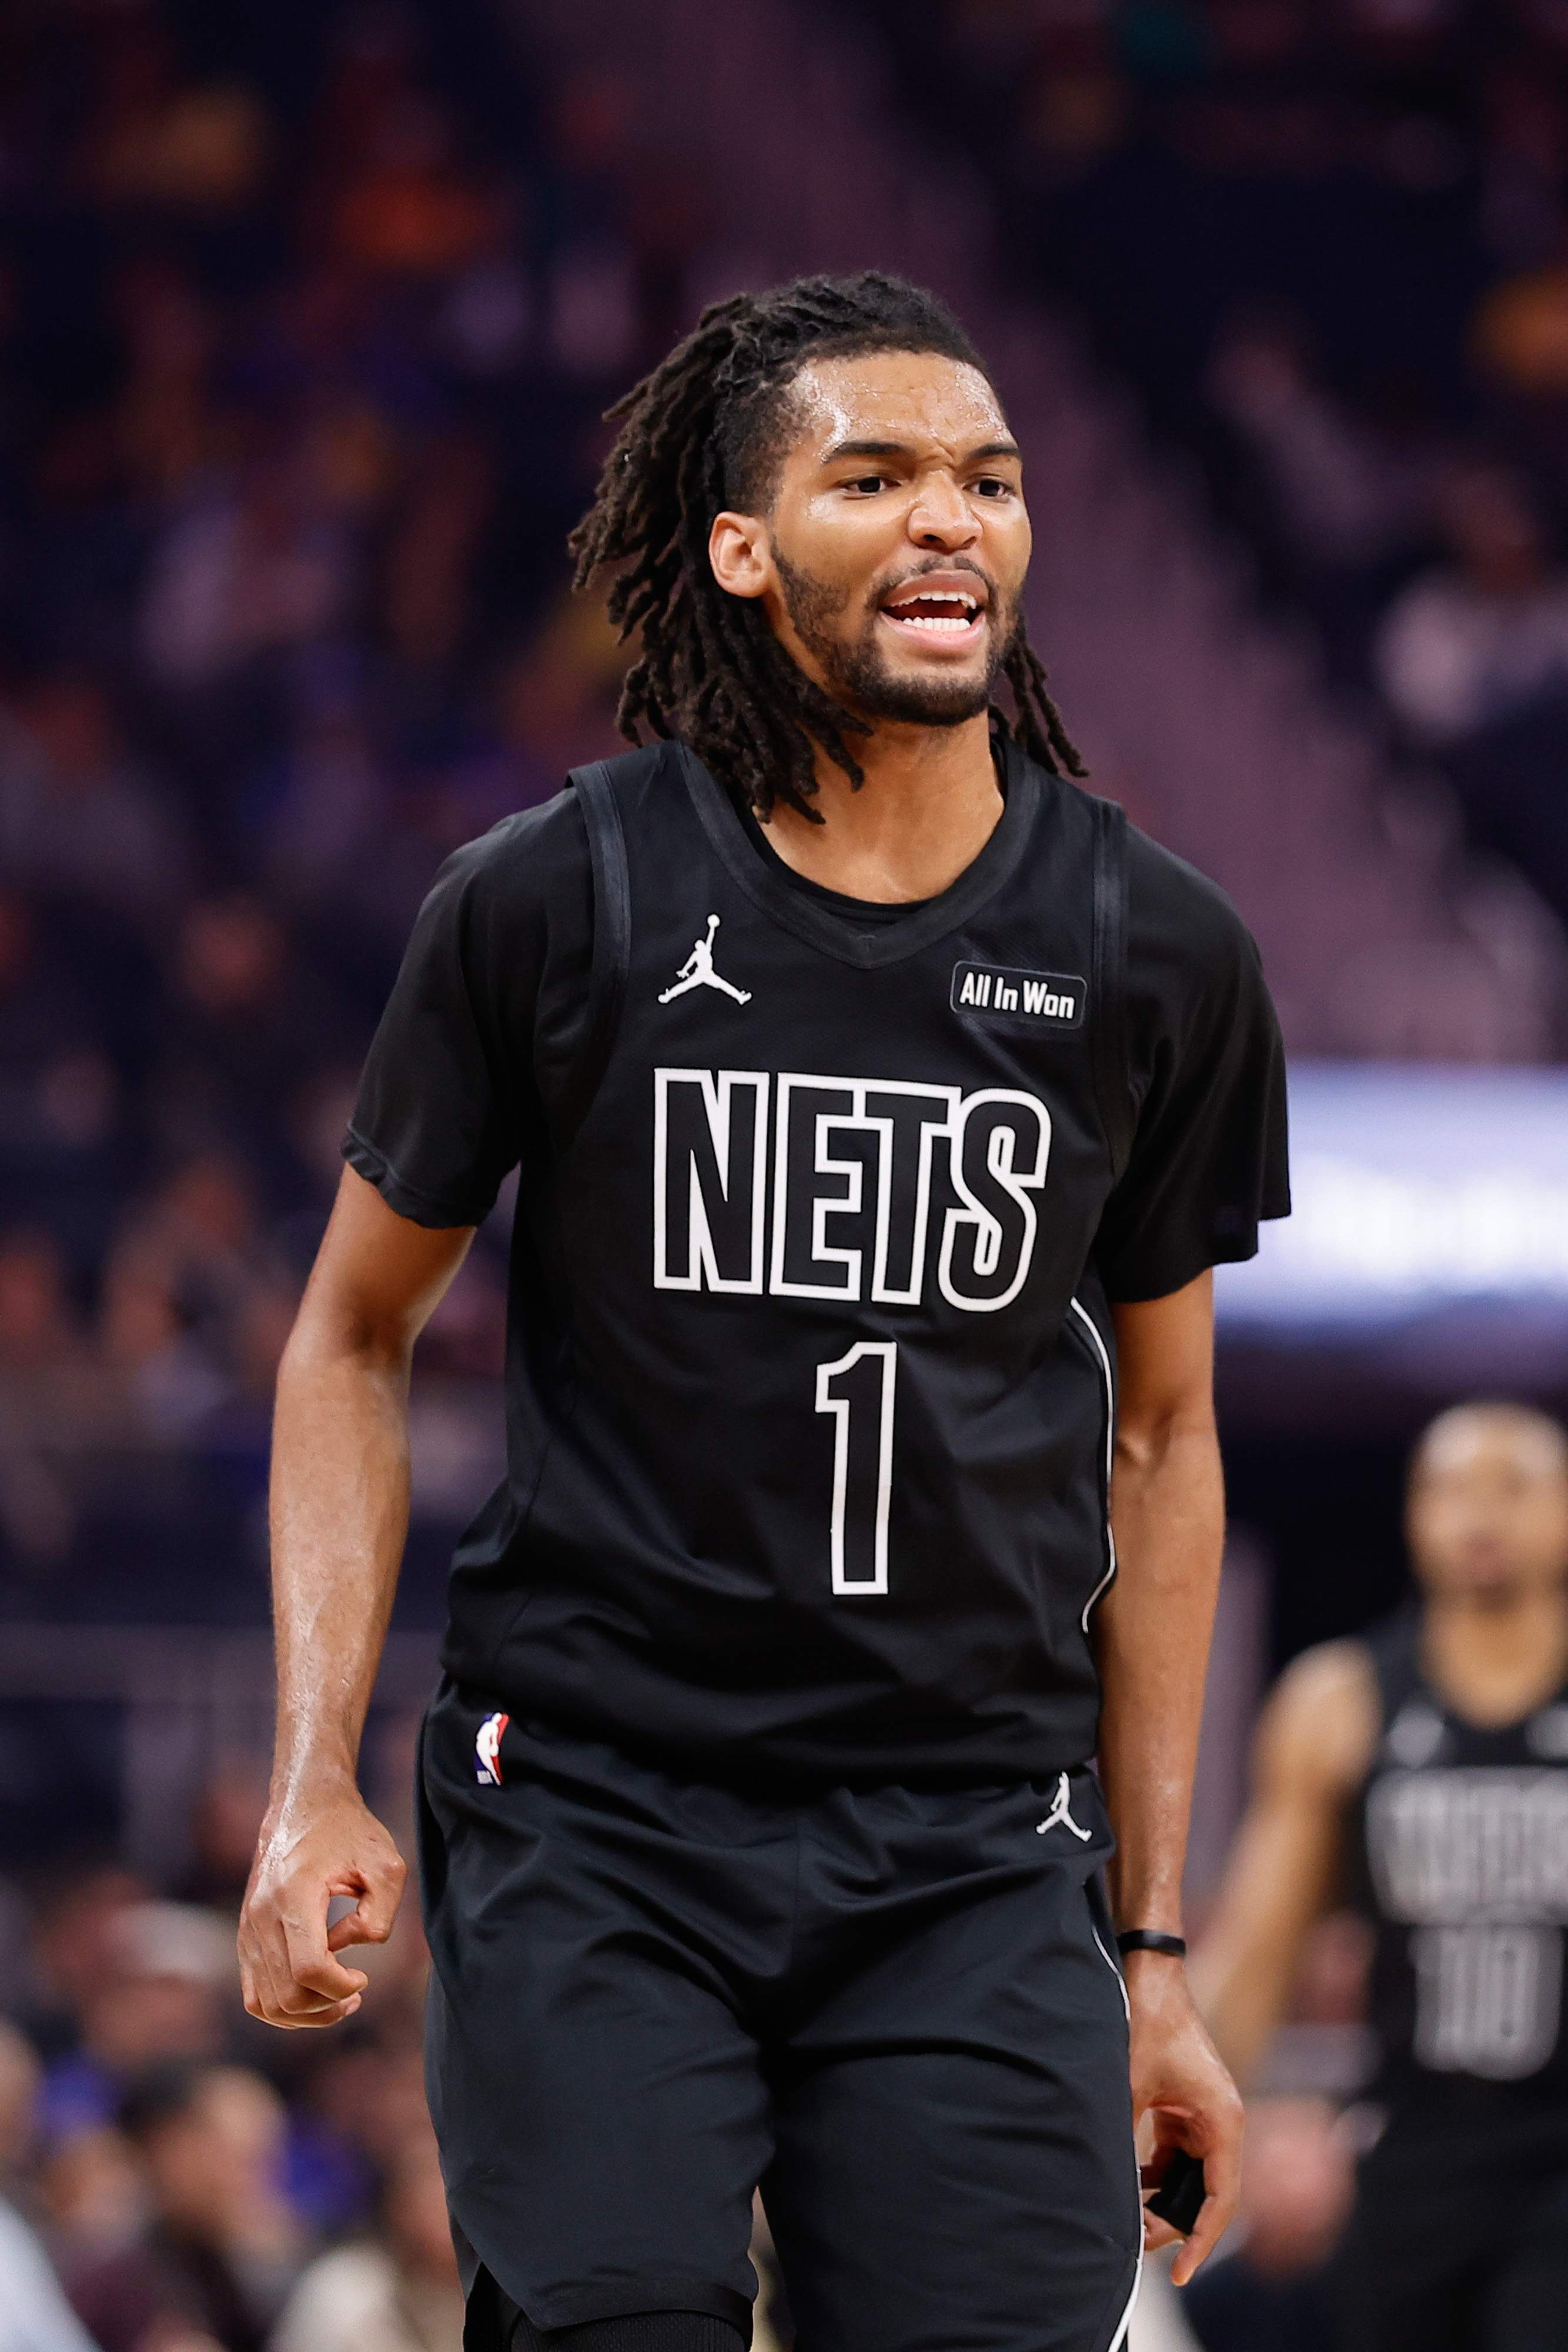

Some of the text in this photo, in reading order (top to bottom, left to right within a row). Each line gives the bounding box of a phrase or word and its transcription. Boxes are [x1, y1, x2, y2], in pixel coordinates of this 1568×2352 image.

[959, 972, 1075, 1019] All In Won
[654, 1068, 1052, 1312] NETS
[815, 1341, 897, 1595] 1
